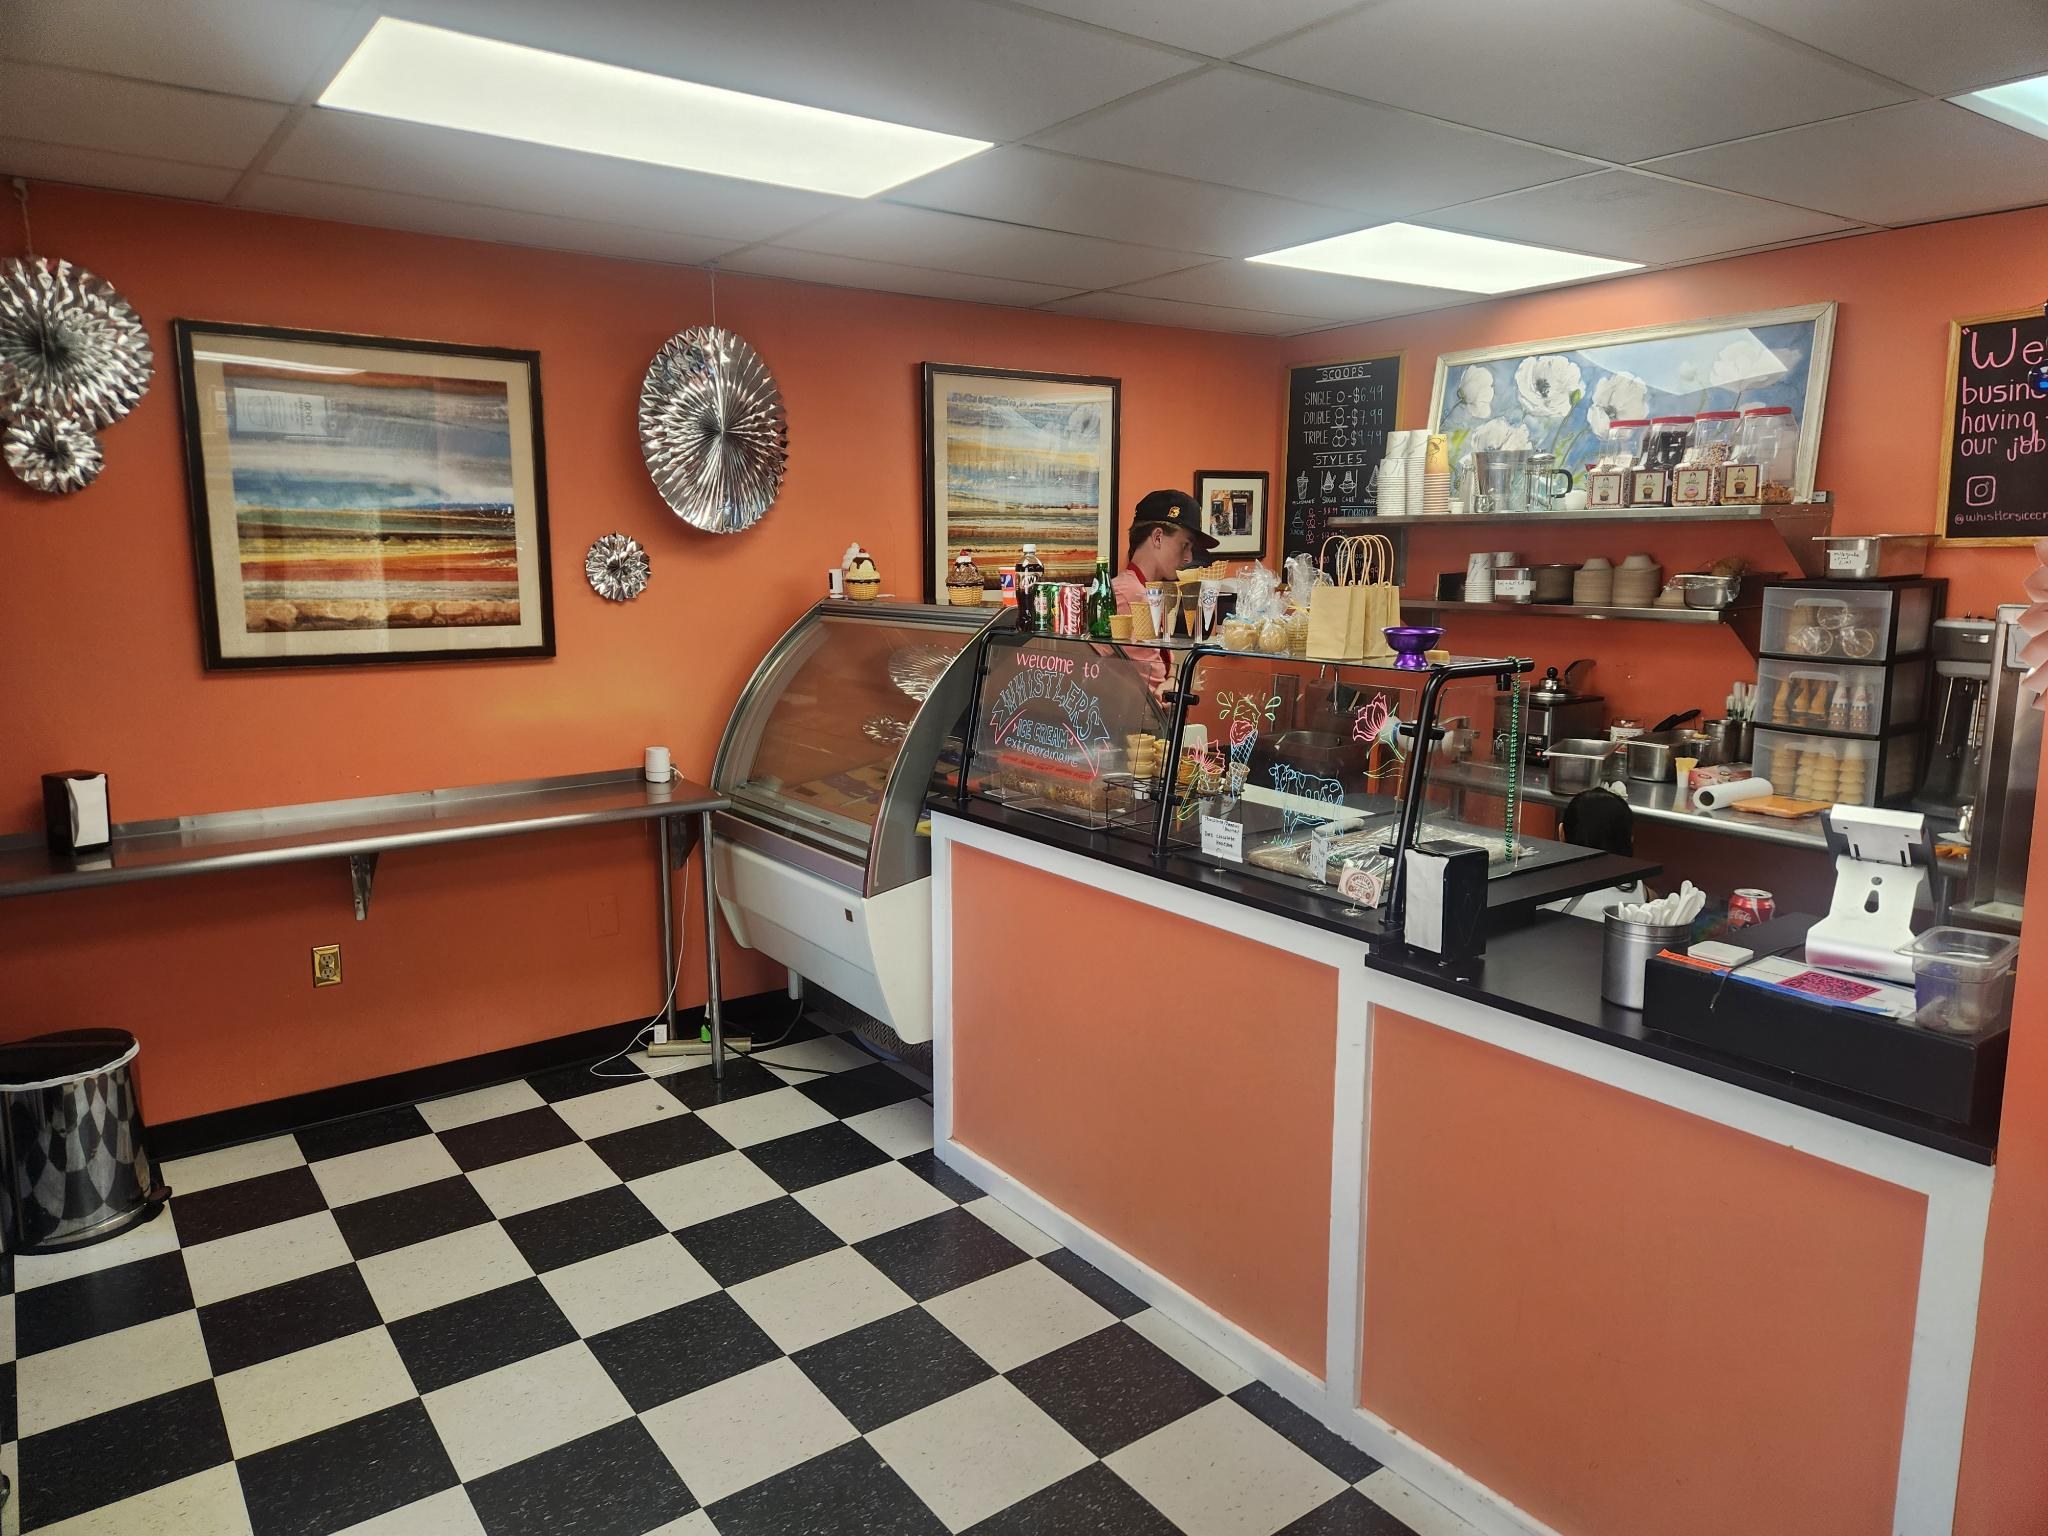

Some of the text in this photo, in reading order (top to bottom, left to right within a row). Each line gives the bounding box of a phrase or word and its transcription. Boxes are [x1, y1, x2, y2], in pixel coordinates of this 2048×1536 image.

[1322, 366, 1364, 380] SCOOPS
[1304, 390, 1333, 405] SINGLE
[1303, 410, 1331, 425] DOUBLE
[1960, 408, 2036, 446] having
[1303, 430, 1328, 445] TRIPLE
[1961, 437, 1998, 457] our
[1315, 453, 1363, 466] STYLES
[1340, 508, 1376, 517] TOPPING
[1016, 652, 1100, 679] welcome to
[1016, 718, 1069, 749] ICE CREAM
